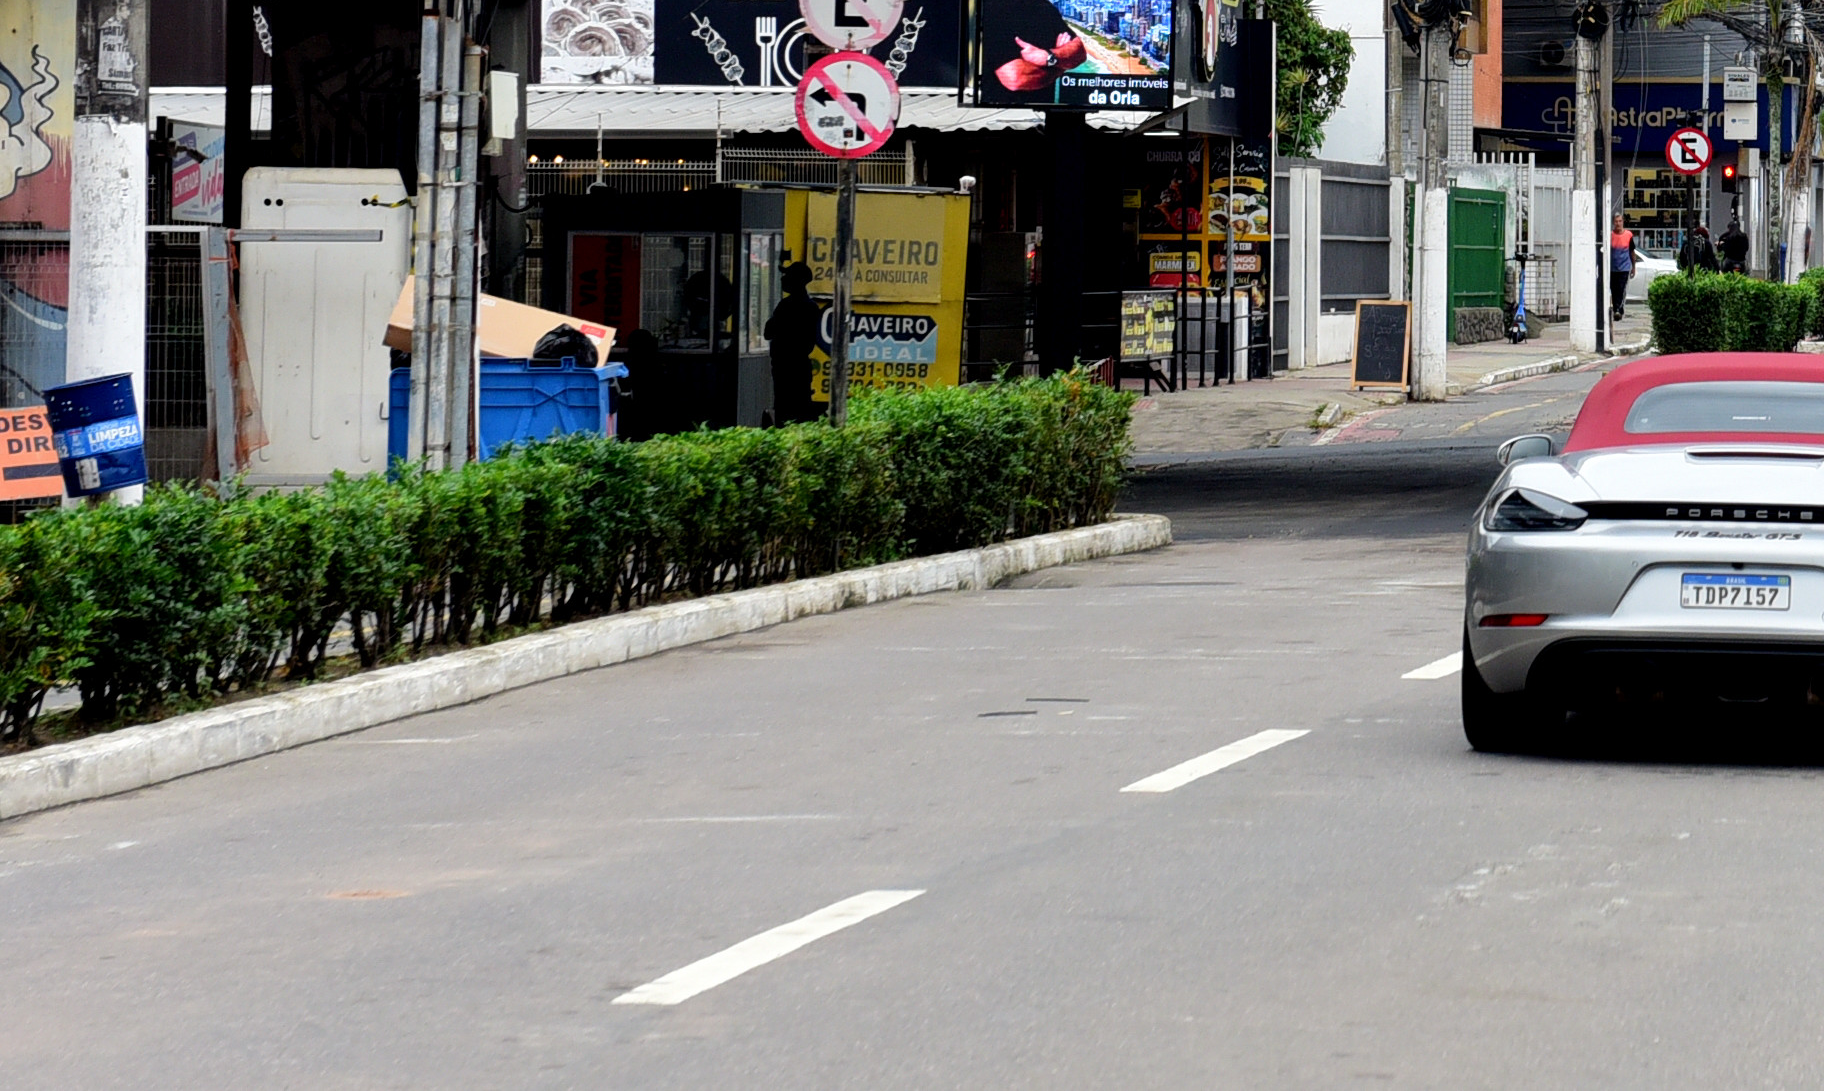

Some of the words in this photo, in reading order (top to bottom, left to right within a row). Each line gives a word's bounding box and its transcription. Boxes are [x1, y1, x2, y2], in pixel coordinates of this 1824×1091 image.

[1061, 76, 1077, 88] Os
[1078, 75, 1127, 88] melhores
[1128, 76, 1169, 90] imóveis
[1088, 90, 1107, 105] da
[1110, 90, 1141, 106] Orla
[1146, 150, 1202, 163] CHURRACO
[812, 237, 939, 266] CAVEIRO
[1154, 260, 1196, 271] MARMIEX
[1219, 263, 1256, 271] ASADO
[865, 269, 928, 284] CONSULTAR
[855, 346, 928, 361] IDEAL
[822, 361, 929, 378] 931-0958
[88, 424, 138, 444] LIMPEZA
[7, 435, 52, 454] DIR
[1666, 507, 1814, 520] PORSCHE
[1674, 530, 1699, 538] 718
[1765, 532, 1803, 541] GTS
